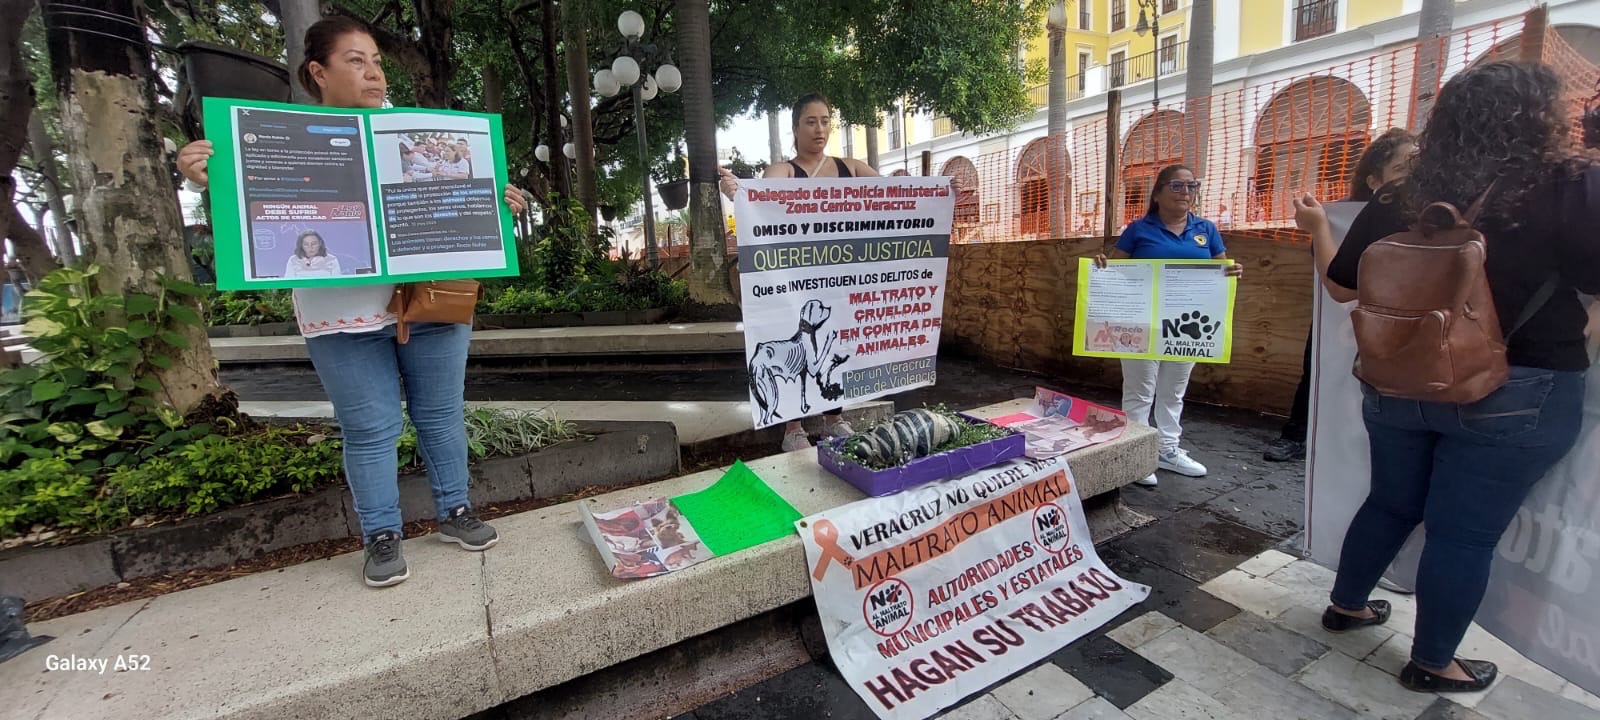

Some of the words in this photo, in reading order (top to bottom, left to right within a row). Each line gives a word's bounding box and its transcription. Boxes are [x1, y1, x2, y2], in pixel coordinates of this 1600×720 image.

[748, 188, 810, 204] Delegado
[813, 187, 828, 199] de
[830, 187, 842, 199] la
[844, 185, 884, 198] Policía
[886, 184, 949, 198] Ministerial
[786, 202, 818, 214] Zona
[820, 200, 862, 213] Centro
[864, 200, 916, 211] Veracruz
[753, 224, 797, 237] OMISO
[801, 223, 810, 235] Y
[814, 218, 934, 233] DISCRIMINATORIO
[753, 244, 853, 271] QUEREMOS
[858, 240, 933, 262] JUSTICIA
[753, 285, 773, 297] Que
[776, 284, 787, 294] se
[789, 275, 856, 292] INVESTIGUEN
[859, 273, 878, 285] LOS
[881, 270, 919, 282] DELITOS
[921, 268, 933, 279] de
[849, 287, 926, 305] MALTRATO
[928, 285, 939, 298] Y
[854, 303, 931, 321] CRUELDAD
[840, 327, 859, 341] EN
[862, 320, 919, 337] CONTRA
[922, 318, 941, 330] DE
[856, 335, 929, 355] ANIMALES.
[1163, 347, 1214, 358] ANIMAL
[1176, 340, 1215, 348] MALTRATO
[846, 371, 865, 383] Por
[868, 368, 882, 379] un
[885, 358, 931, 376] Veracruz
[873, 379, 887, 393] de
[890, 370, 937, 389] Violencia
[850, 498, 943, 550] VERACRUZ
[946, 488, 970, 508] NO
[972, 464, 1029, 498] QUIERE
[856, 511, 978, 587] MALTRATO
[987, 475, 1066, 527] ANIMAL
[876, 590, 999, 659] MUNICIPALES
[997, 581, 1009, 600] Y
[1010, 544, 1084, 596] ESTATALES
[880, 600, 907, 616] MALTRATO
[875, 607, 910, 629] ANIMAL
[864, 640, 987, 710] HAGAN
[972, 618, 1025, 656] SU
[1008, 567, 1122, 632] TRABAJO
